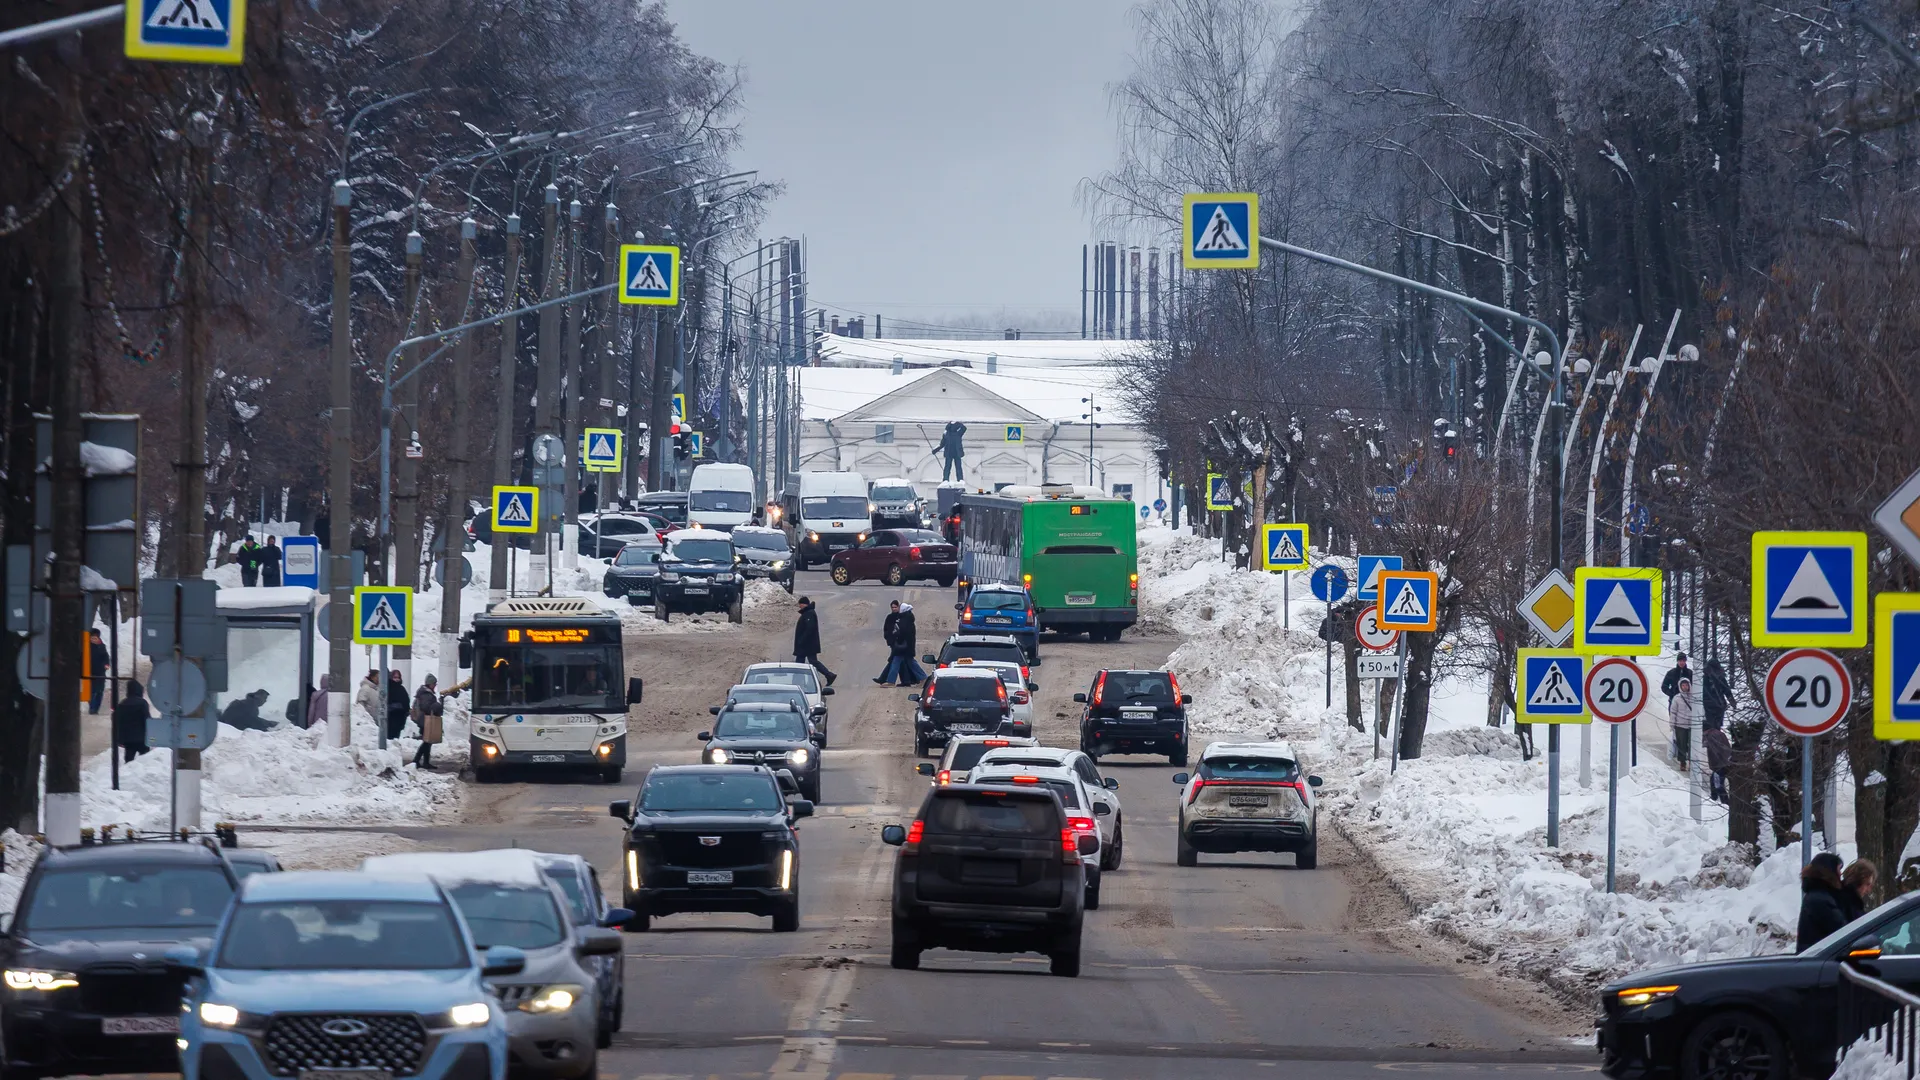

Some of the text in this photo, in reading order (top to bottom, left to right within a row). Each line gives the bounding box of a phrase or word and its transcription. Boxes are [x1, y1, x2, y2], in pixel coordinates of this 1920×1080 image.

[508, 629, 520, 642] 10
[1368, 662, 1383, 672] 50
[1599, 678, 1634, 703] 20
[1785, 675, 1832, 708] 20
